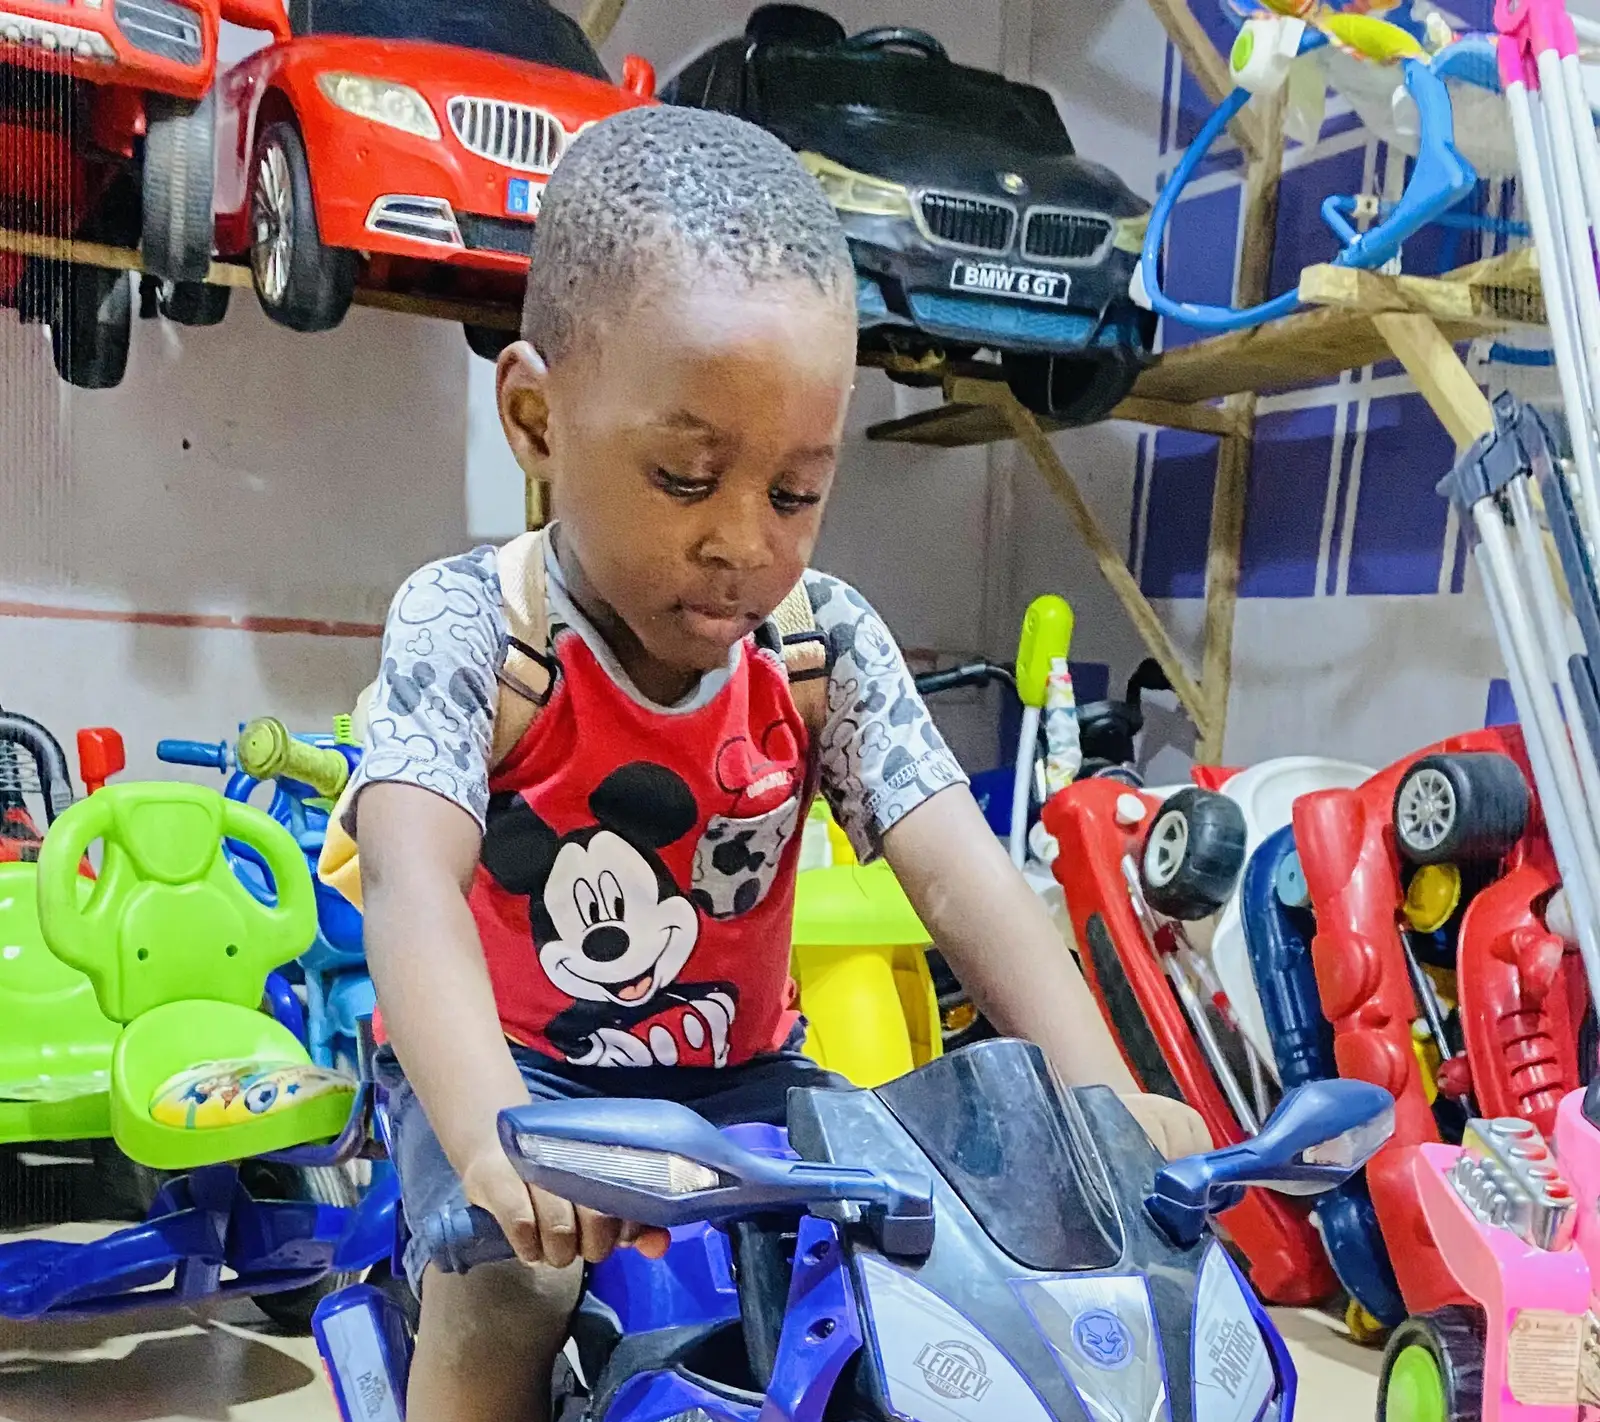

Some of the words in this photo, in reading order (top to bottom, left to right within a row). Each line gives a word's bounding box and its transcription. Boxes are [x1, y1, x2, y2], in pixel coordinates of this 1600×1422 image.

[963, 265, 1016, 291] BMW
[1018, 274, 1030, 293] 6
[1032, 276, 1059, 297] GT
[1209, 1317, 1234, 1362] BLACK
[1210, 1320, 1258, 1400] PANTHER
[916, 1345, 989, 1397] LEGACY
